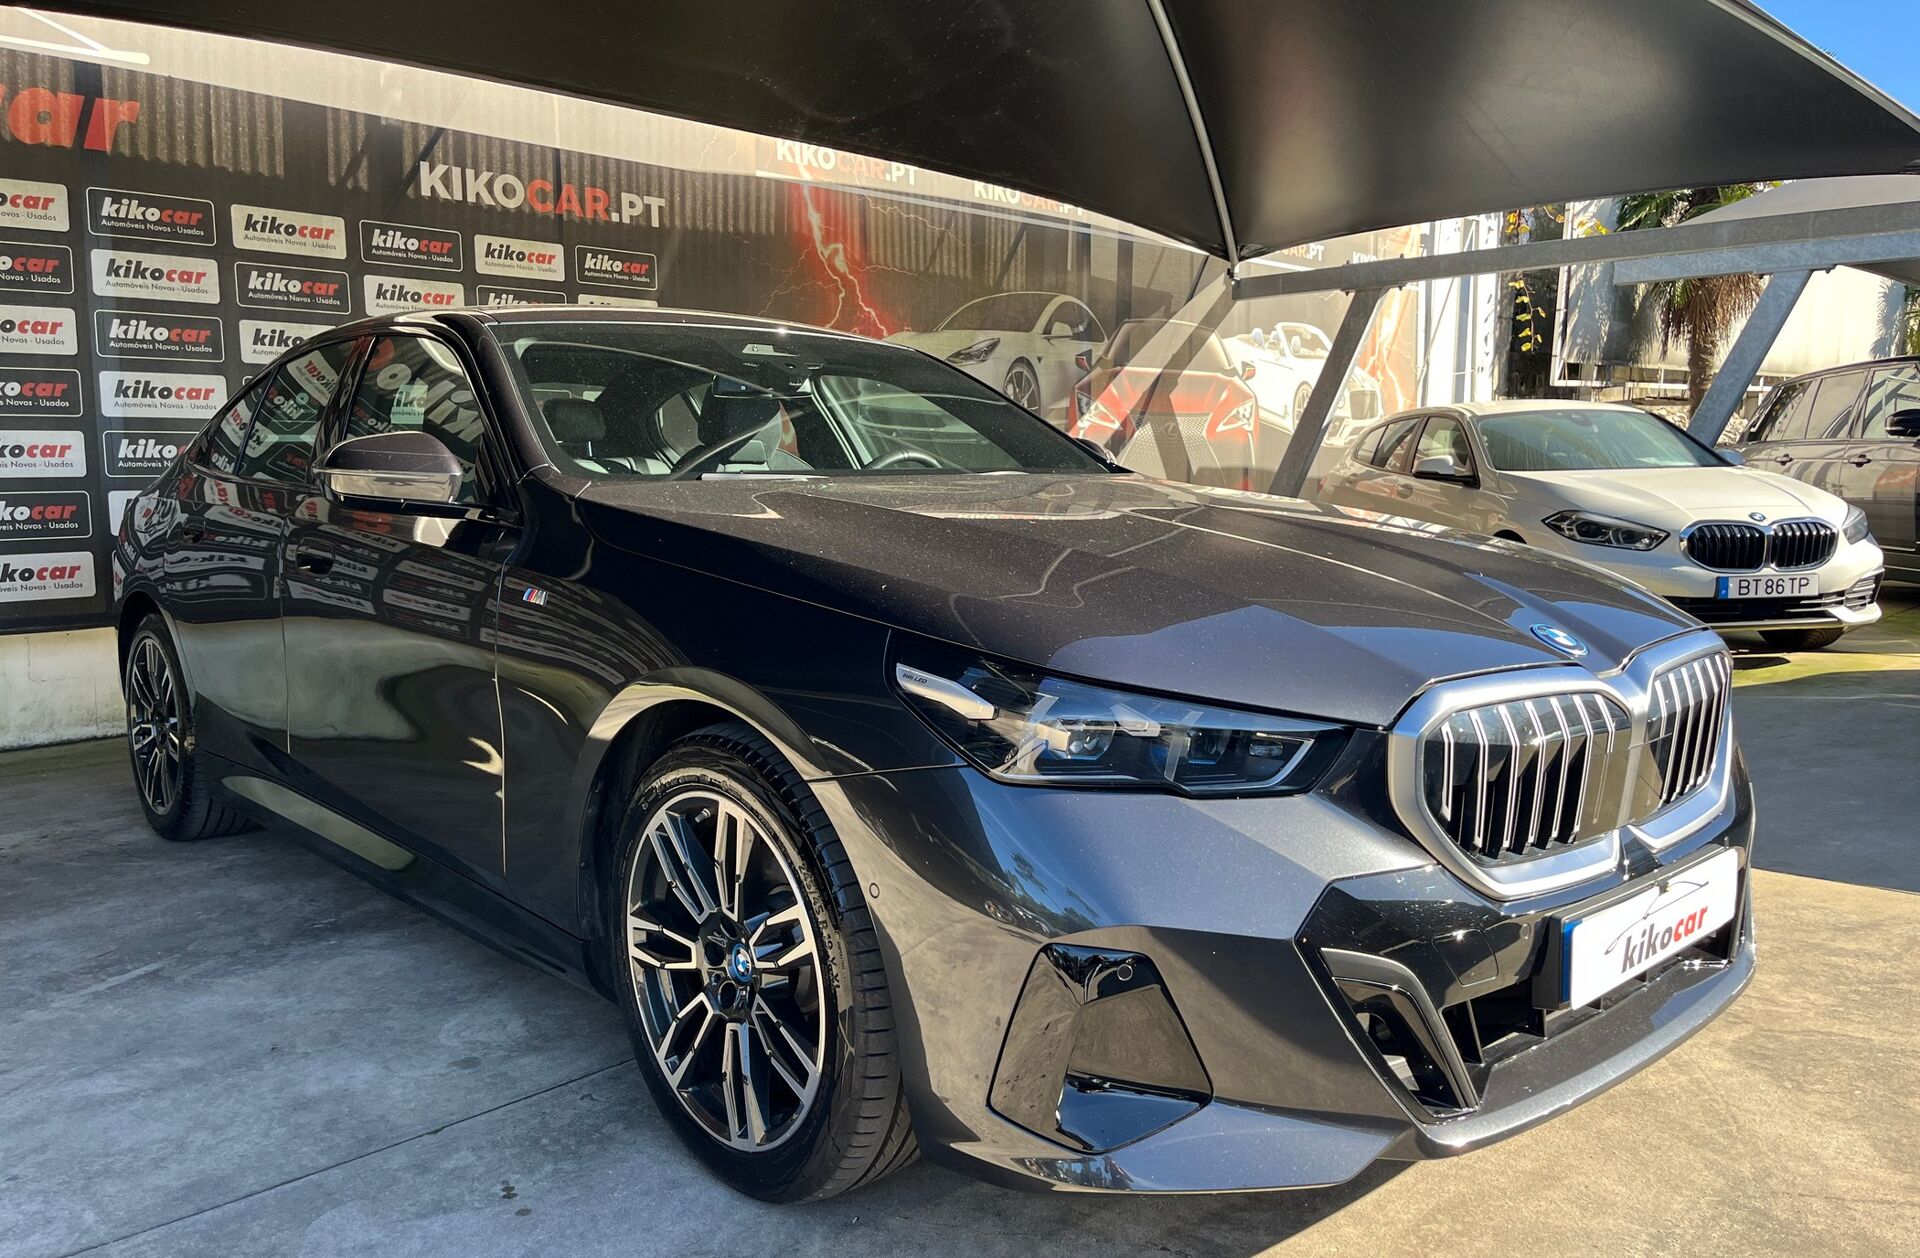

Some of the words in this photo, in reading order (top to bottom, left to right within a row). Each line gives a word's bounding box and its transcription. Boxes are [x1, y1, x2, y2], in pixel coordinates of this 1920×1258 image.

[0, 85, 140, 152] ar
[777, 140, 917, 186] KIKOCAR.PT
[420, 161, 666, 227] KIKOCAR.PT
[27, 212, 57, 221] Usados
[101, 197, 204, 226] kikocar
[101, 219, 145, 230] Automóveis
[147, 223, 171, 233] Novos
[177, 224, 204, 236] Usados
[244, 214, 335, 241] kikocar
[244, 234, 283, 245] Automóveis
[285, 238, 307, 247] Novos
[313, 240, 337, 250] Usados
[371, 229, 453, 254] kikocar
[371, 248, 407, 258] Automóveis
[408, 252, 428, 260] Novos
[432, 254, 454, 263] Usados
[485, 243, 556, 265] kikocar
[584, 253, 649, 275] kikocar
[31, 275, 61, 284] Usados
[105, 258, 207, 284] kikocar
[105, 280, 149, 290] Automóveis
[151, 283, 175, 292] Novos
[182, 284, 208, 294] Usados
[248, 271, 339, 297] kikocar
[376, 283, 455, 305] kikocar
[248, 291, 287, 301] Automóveis
[289, 294, 311, 303] Novos
[316, 296, 340, 306] Usados
[2, 336, 28, 345] Novos
[35, 337, 65, 346] Usados
[109, 318, 212, 343] kikocar
[109, 341, 153, 350] Automóveis
[155, 342, 179, 351] Novos
[185, 344, 213, 353] Usados
[114, 379, 215, 400] kikocar
[6, 399, 32, 407] Novos
[40, 399, 70, 407] Usados
[113, 401, 158, 409] Automóveis
[190, 402, 217, 410] Usados
[44, 460, 74, 468] Usados
[15, 522, 42, 531] Novos
[48, 521, 79, 530] Usados
[0, 562, 81, 583] kocar
[20, 583, 47, 592] Novos
[53, 581, 84, 590] Usados
[1621, 906, 1708, 974] kikocar
